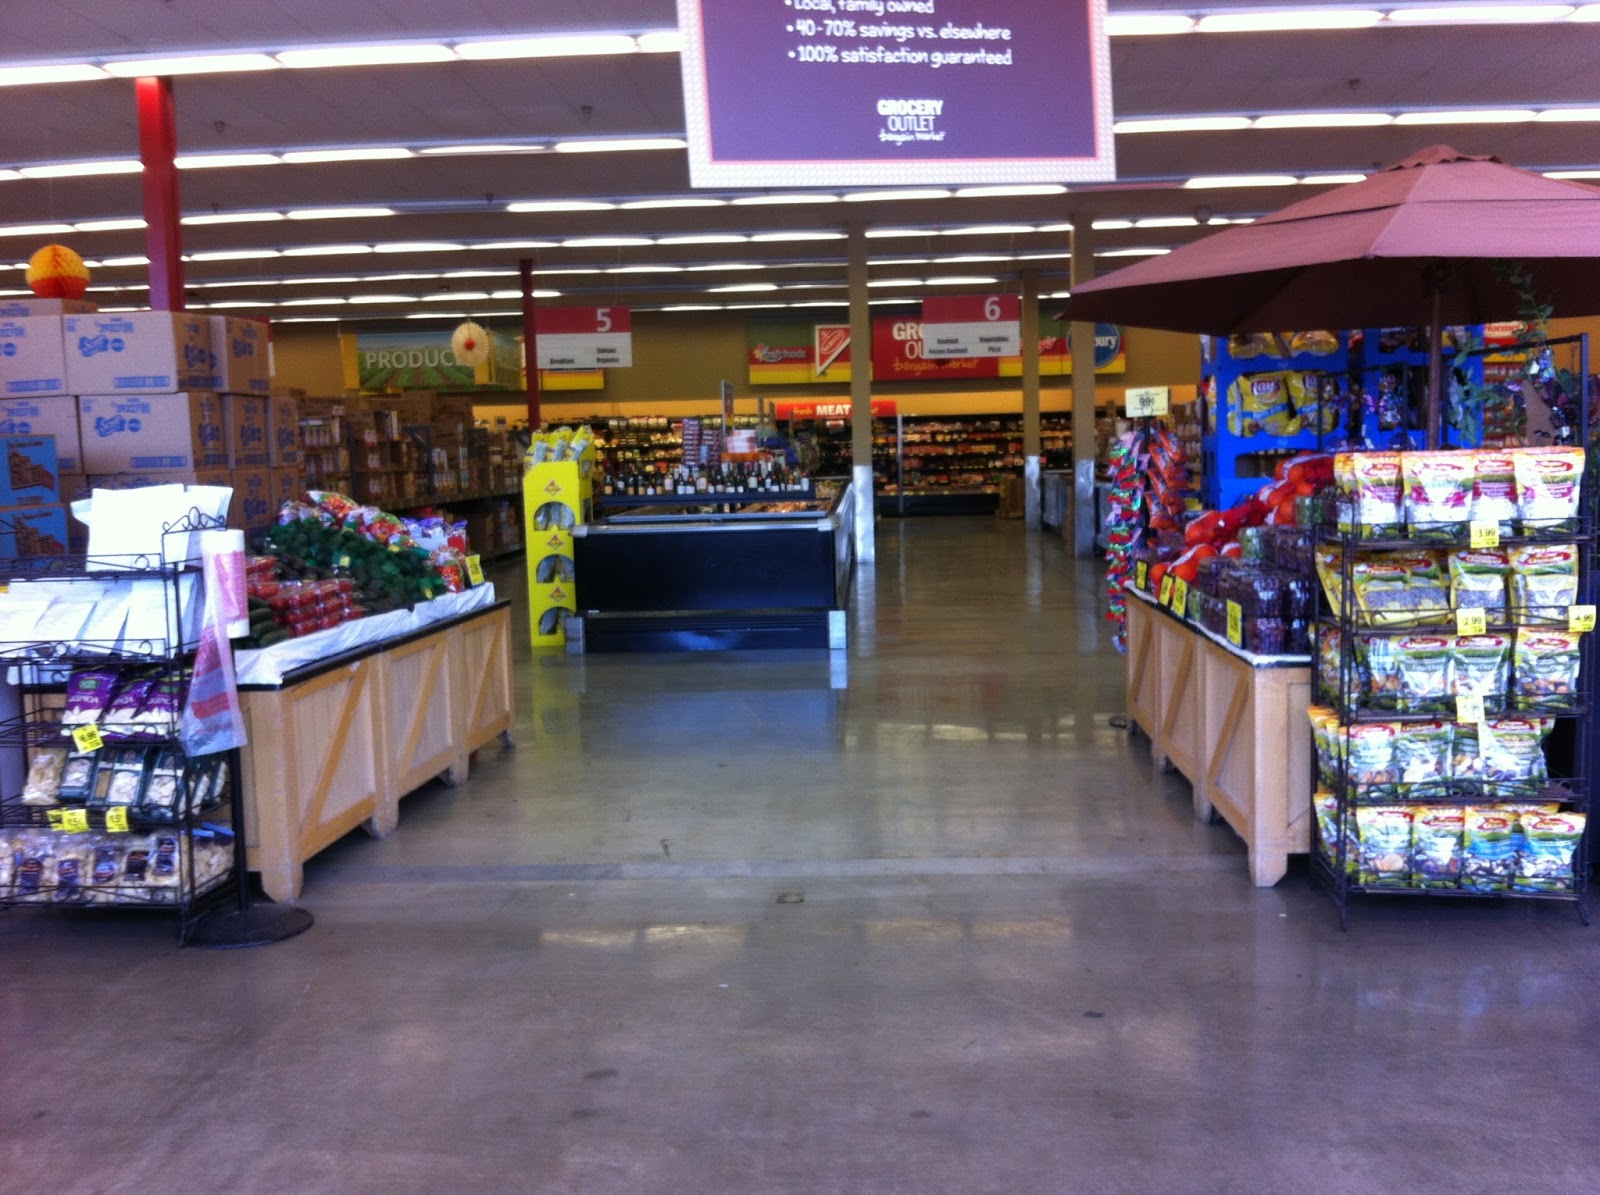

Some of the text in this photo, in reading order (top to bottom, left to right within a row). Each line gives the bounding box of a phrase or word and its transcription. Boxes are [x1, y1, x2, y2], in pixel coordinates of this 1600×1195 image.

[887, 0, 935, 14] owned
[796, 19, 1012, 41] 40-70% savings vs. elsewhere
[797, 45, 1013, 68] 100% satisfaction guaranteed
[877, 99, 944, 115] GROCERY
[887, 115, 936, 131] OUTLET
[984, 296, 1001, 320] 6
[596, 308, 612, 332] 5
[365, 349, 462, 369] PRODUC
[816, 399, 851, 415] MEAT
